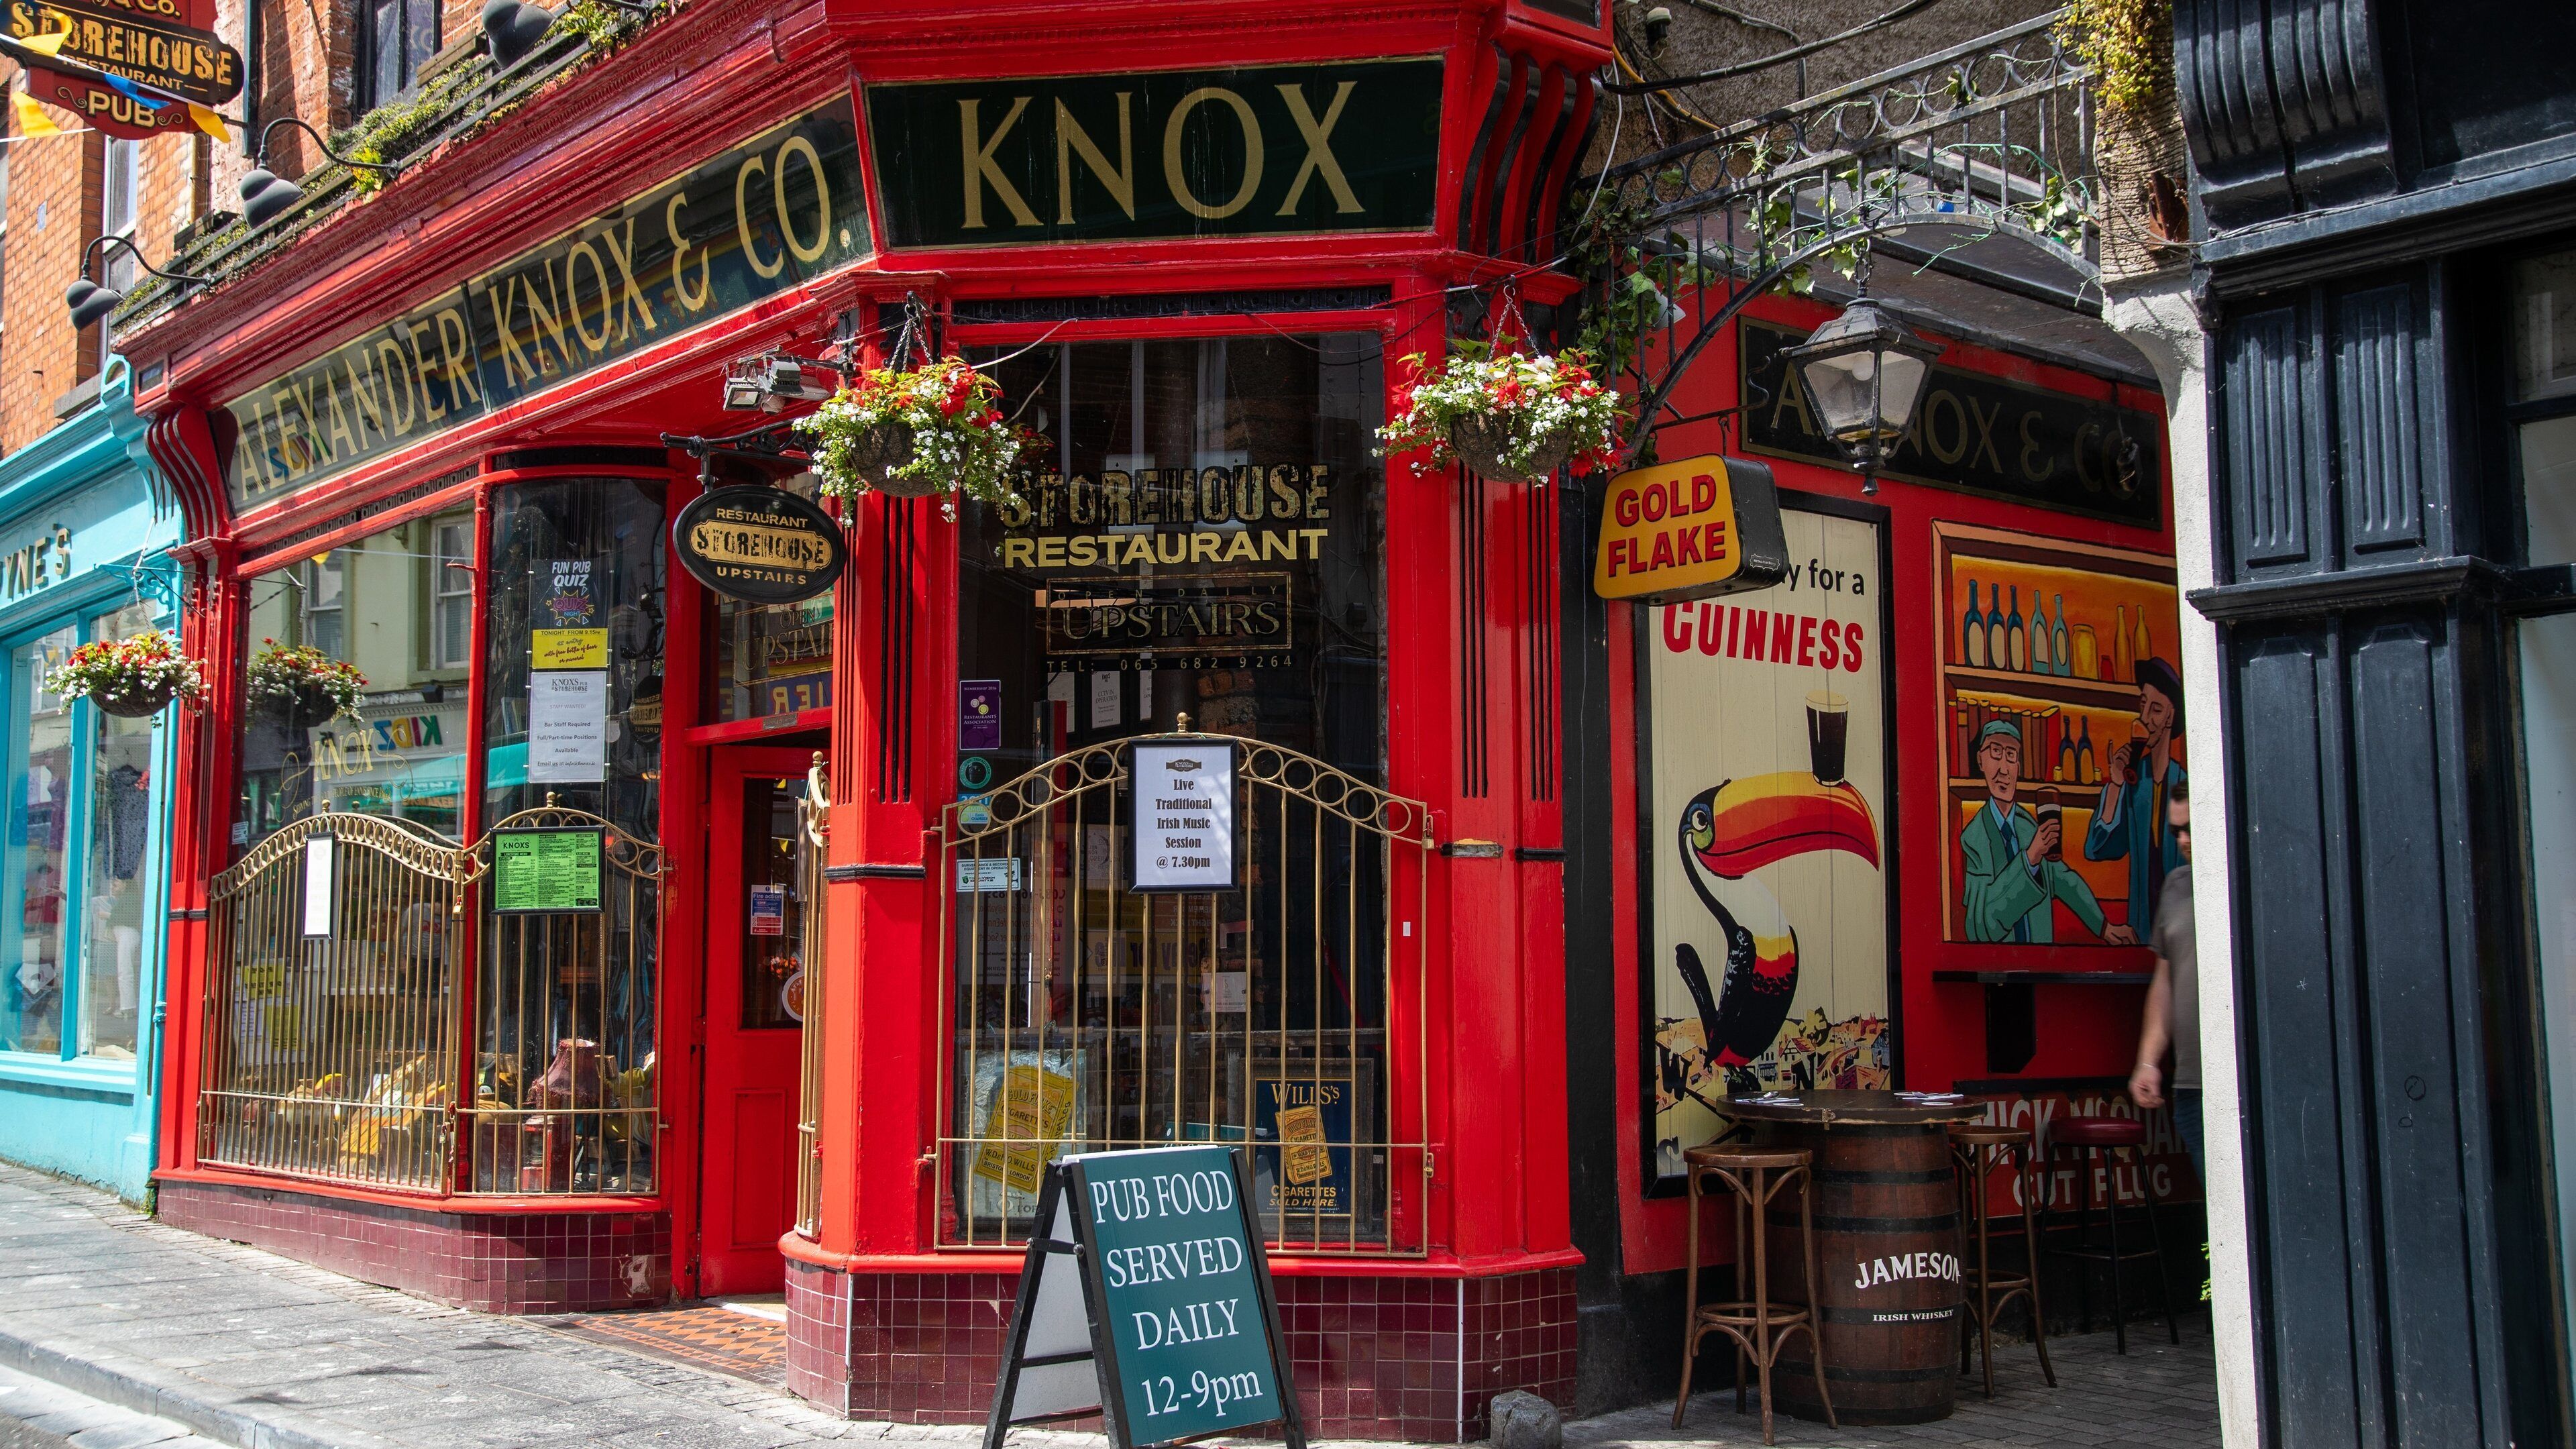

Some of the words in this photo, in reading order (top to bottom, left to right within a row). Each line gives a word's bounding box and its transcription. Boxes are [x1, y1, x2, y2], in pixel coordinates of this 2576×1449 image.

[11, 2, 233, 86] STOREHOUSE
[62, 54, 184, 91] RESTAURANT
[88, 89, 156, 128] PUB
[957, 80, 1366, 229] KNOX
[235, 307, 482, 502] ALEXANDER
[488, 215, 657, 388] KNOX
[667, 191, 710, 312] &
[735, 136, 851, 280] CO.
[1002, 464, 1330, 528] STOREHOUSE
[1615, 474, 1717, 529] GOLD
[716, 508, 808, 529] RESTAURANT
[0, 523, 71, 601] YNE'S
[696, 526, 824, 564] STOREHOUSE
[1005, 529, 1329, 569] RESTAURANT
[1607, 521, 1727, 579] FLAKE
[551, 561, 569, 574] FUN
[572, 561, 592, 574] PUB
[553, 574, 589, 587] QUIZ
[716, 566, 807, 586] UPSTAIRS
[1808, 558, 1845, 593] for
[1851, 573, 1865, 596] a
[1061, 602, 1281, 640] UPSTAIRS
[1662, 601, 1864, 674] GUINNESS
[551, 678, 579, 686] KNOXS
[1046, 660, 1095, 673] TEL:
[1120, 657, 1159, 672] 065
[1179, 657, 1219, 669] 682
[1239, 655, 1293, 668] 9264
[1095, 695, 1118, 704] OPERATION
[313, 727, 376, 783] KNOX
[1173, 779, 1194, 790] Live
[1155, 798, 1212, 810] Traditional
[1157, 818, 1180, 829] Irish
[1183, 818, 1211, 829] Music
[1157, 855, 1169, 869] @
[1171, 855, 1211, 869] 7.30pm
[1165, 837, 1201, 849] Session
[1009, 1171, 1030, 1182] LONDON
[2012, 1170, 2076, 1208] CUT
[2094, 1163, 2172, 1203] PLUG
[1090, 1177, 1151, 1225] PUB
[1152, 1170, 1234, 1218] FOOD
[1106, 1236, 1244, 1289] SERVED
[1132, 1297, 1240, 1350] DAILY
[1872, 1313, 1909, 1322] IRISH
[1911, 1309, 1954, 1321] WHISKEY
[1141, 1369, 1264, 1417] 12-9pm
